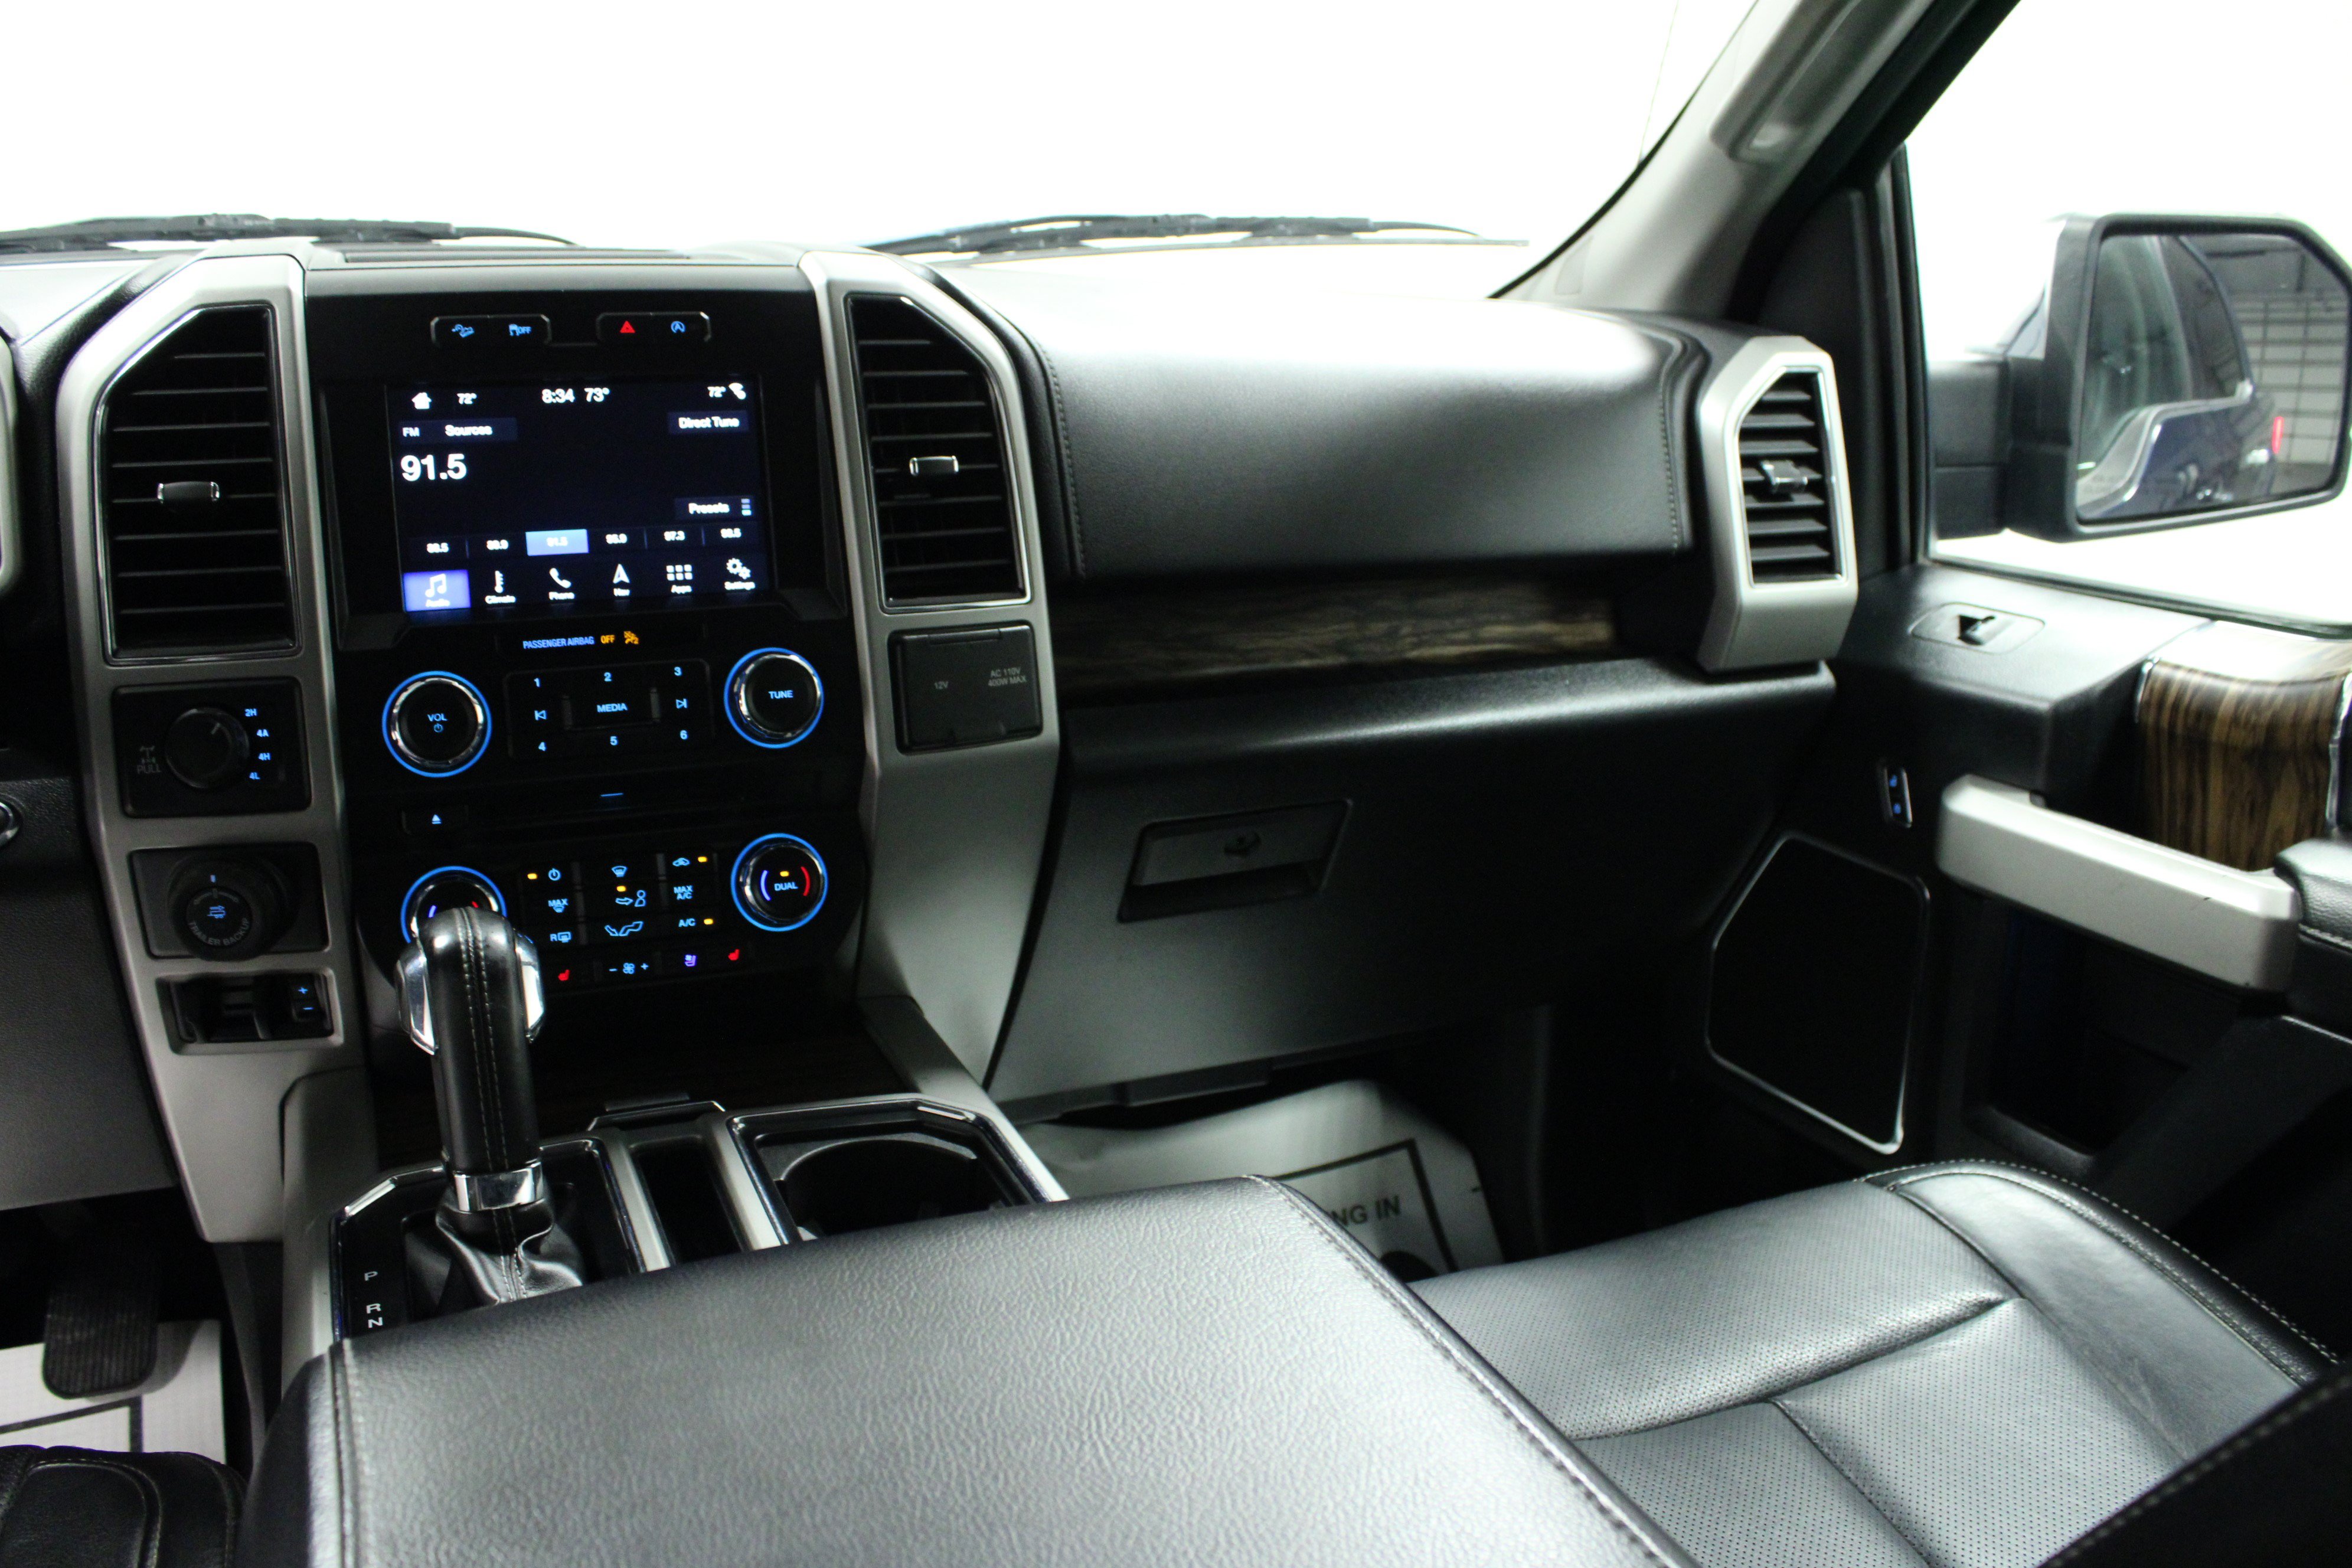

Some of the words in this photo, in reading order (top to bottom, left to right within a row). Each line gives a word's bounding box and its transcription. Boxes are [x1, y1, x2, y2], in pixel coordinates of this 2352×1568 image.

[518, 326, 532, 335] OFF
[541, 388, 576, 404] 8:34
[584, 387, 611, 403] 73°
[678, 417, 711, 429] Direct
[711, 416, 740, 428] Tune
[402, 427, 420, 437] FM
[445, 424, 493, 437] Sources
[400, 453, 468, 482] 91.5
[688, 502, 730, 515] Presets
[671, 584, 693, 594] Apps
[724, 581, 756, 591] Settings
[548, 591, 576, 600] Phone
[613, 587, 631, 597] Nav
[522, 638, 567, 649] PASSENGER
[567, 636, 596, 646] AIRBAG
[600, 635, 615, 644] OFF
[674, 666, 682, 677] 3
[990, 669, 1001, 678] AC
[603, 672, 612, 682] 2
[1009, 675, 1027, 684] MAX
[534, 678, 541, 688] 1
[934, 681, 949, 690] 12V
[768, 690, 794, 700] TUNE
[244, 708, 258, 717] 2H
[596, 703, 628, 713] MEDIA
[427, 713, 448, 723] VOL
[256, 729, 270, 737] 4A
[680, 730, 689, 740] 6
[610, 736, 619, 746] 5
[538, 741, 547, 752] 4
[258, 752, 272, 761] 4H
[136, 763, 161, 775] PULL
[249, 772, 261, 780] 4L
[774, 881, 799, 891] DUAL
[548, 898, 569, 907] MAX
[678, 917, 697, 927] A/C
[1376, 1195, 1400, 1219] IN
[364, 1271, 378, 1281] P
[366, 1303, 381, 1314] R
[368, 1317, 383, 1328] N
